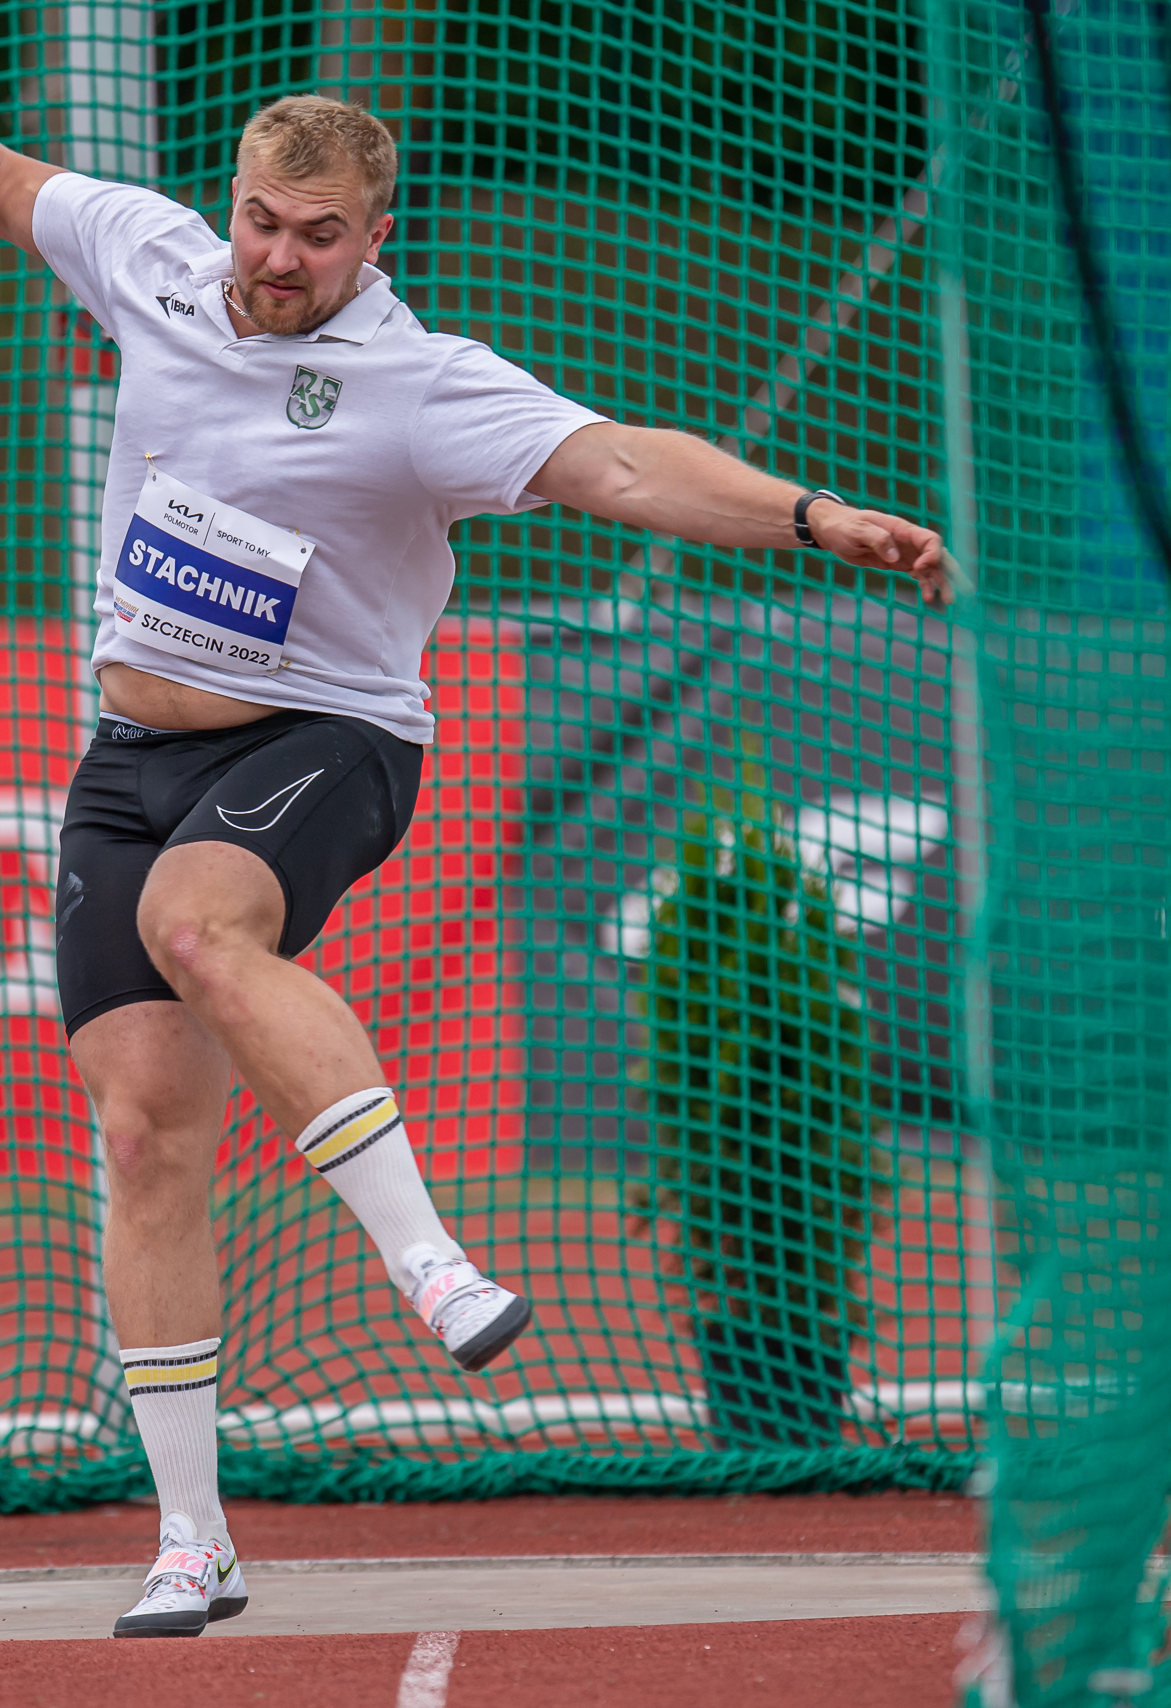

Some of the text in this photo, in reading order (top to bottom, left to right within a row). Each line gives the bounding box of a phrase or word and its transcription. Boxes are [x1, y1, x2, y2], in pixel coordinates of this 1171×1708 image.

[163, 513, 199, 536] POLMOTOR
[168, 499, 204, 523] KIA
[217, 530, 271, 558] SPORT TO MY
[129, 538, 282, 623] STACHNIK
[141, 613, 225, 654] SZCZECIN
[227, 644, 271, 667] 2022
[419, 1271, 457, 1322] NIKE
[149, 1551, 209, 1579] NIKE
